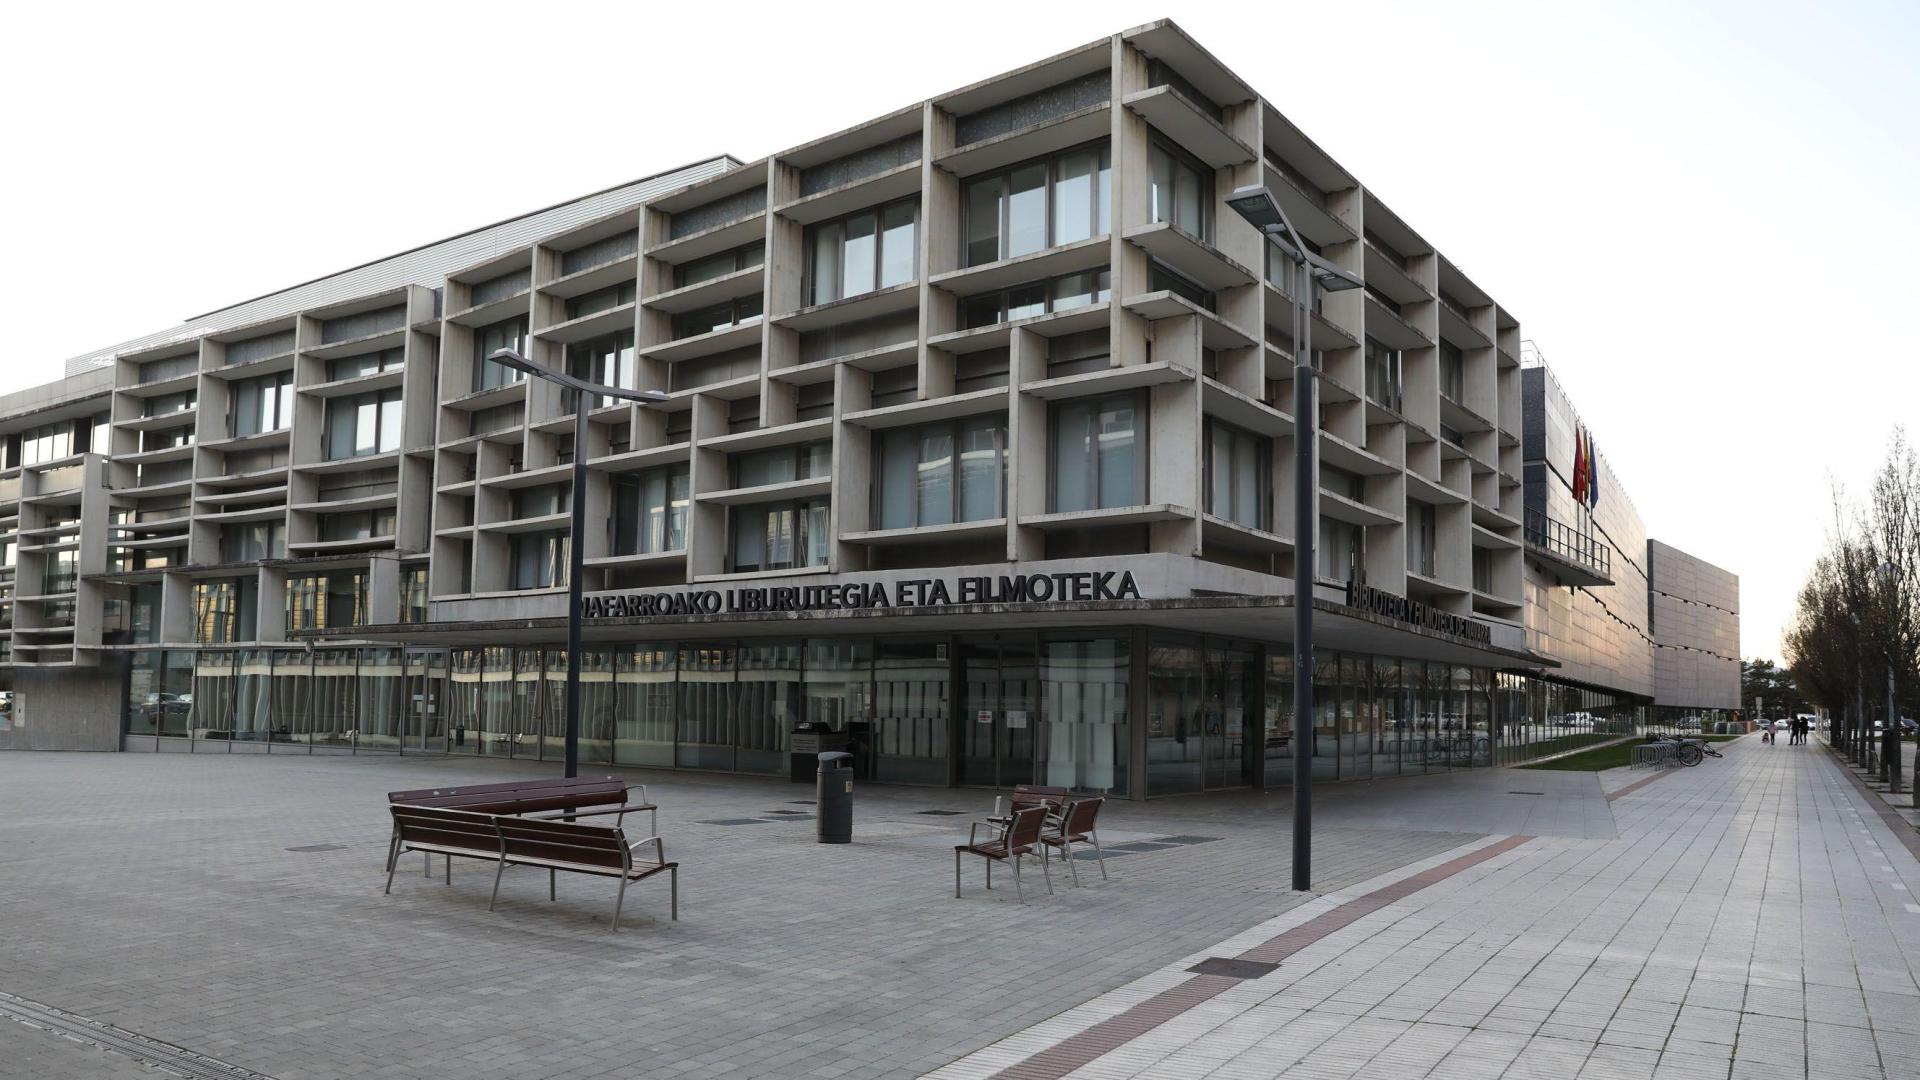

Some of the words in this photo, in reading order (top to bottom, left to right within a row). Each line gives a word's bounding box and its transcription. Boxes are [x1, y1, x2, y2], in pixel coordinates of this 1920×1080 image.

[726, 582, 890, 612] LIBURUTEGIA
[895, 579, 951, 607] ETA
[957, 571, 1141, 604] FILMOTEKA
[1347, 581, 1406, 621] BIBLIOTECA
[1415, 601, 1456, 636] FILMOTECA
[1456, 616, 1466, 638] DE
